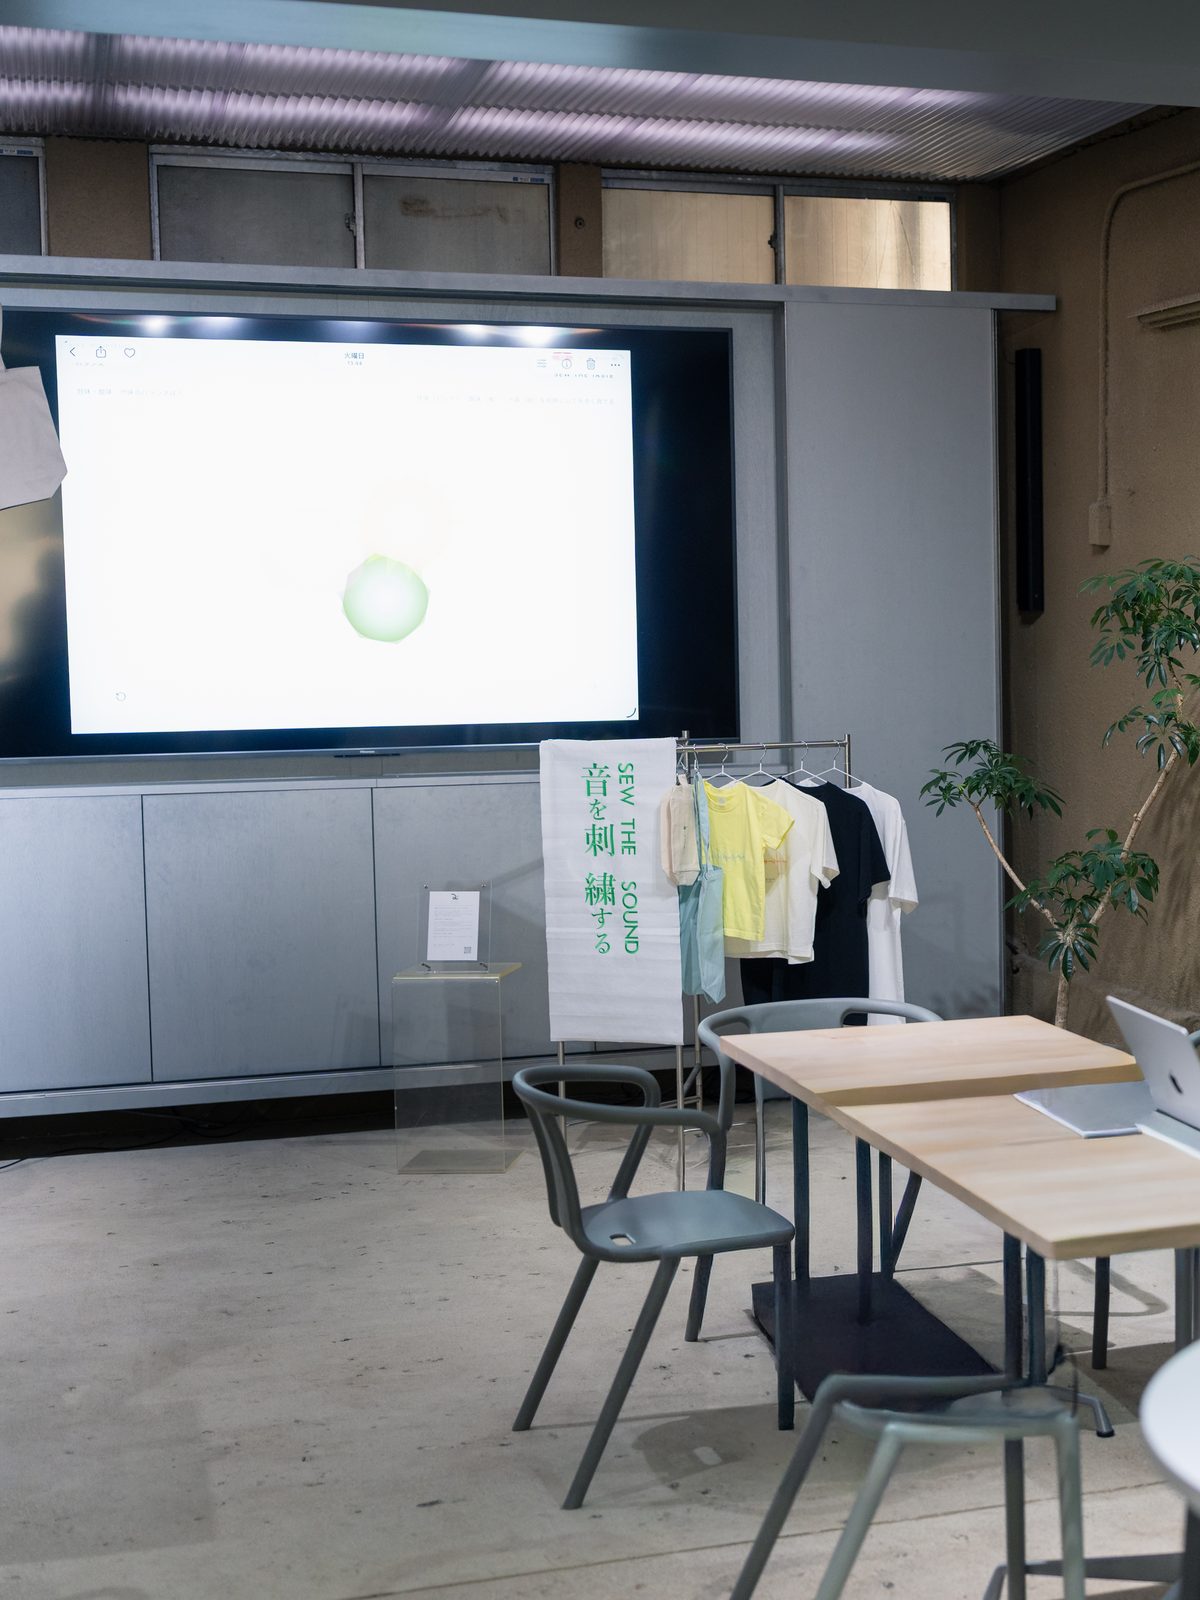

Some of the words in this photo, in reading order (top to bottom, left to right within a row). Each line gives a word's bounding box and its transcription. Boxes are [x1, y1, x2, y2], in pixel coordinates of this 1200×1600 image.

[344, 352, 365, 360] 火曜日
[617, 762, 635, 806] SEW
[581, 762, 616, 955] 音を刺繍する
[620, 817, 637, 856] THE
[620, 880, 639, 955] SOUND
